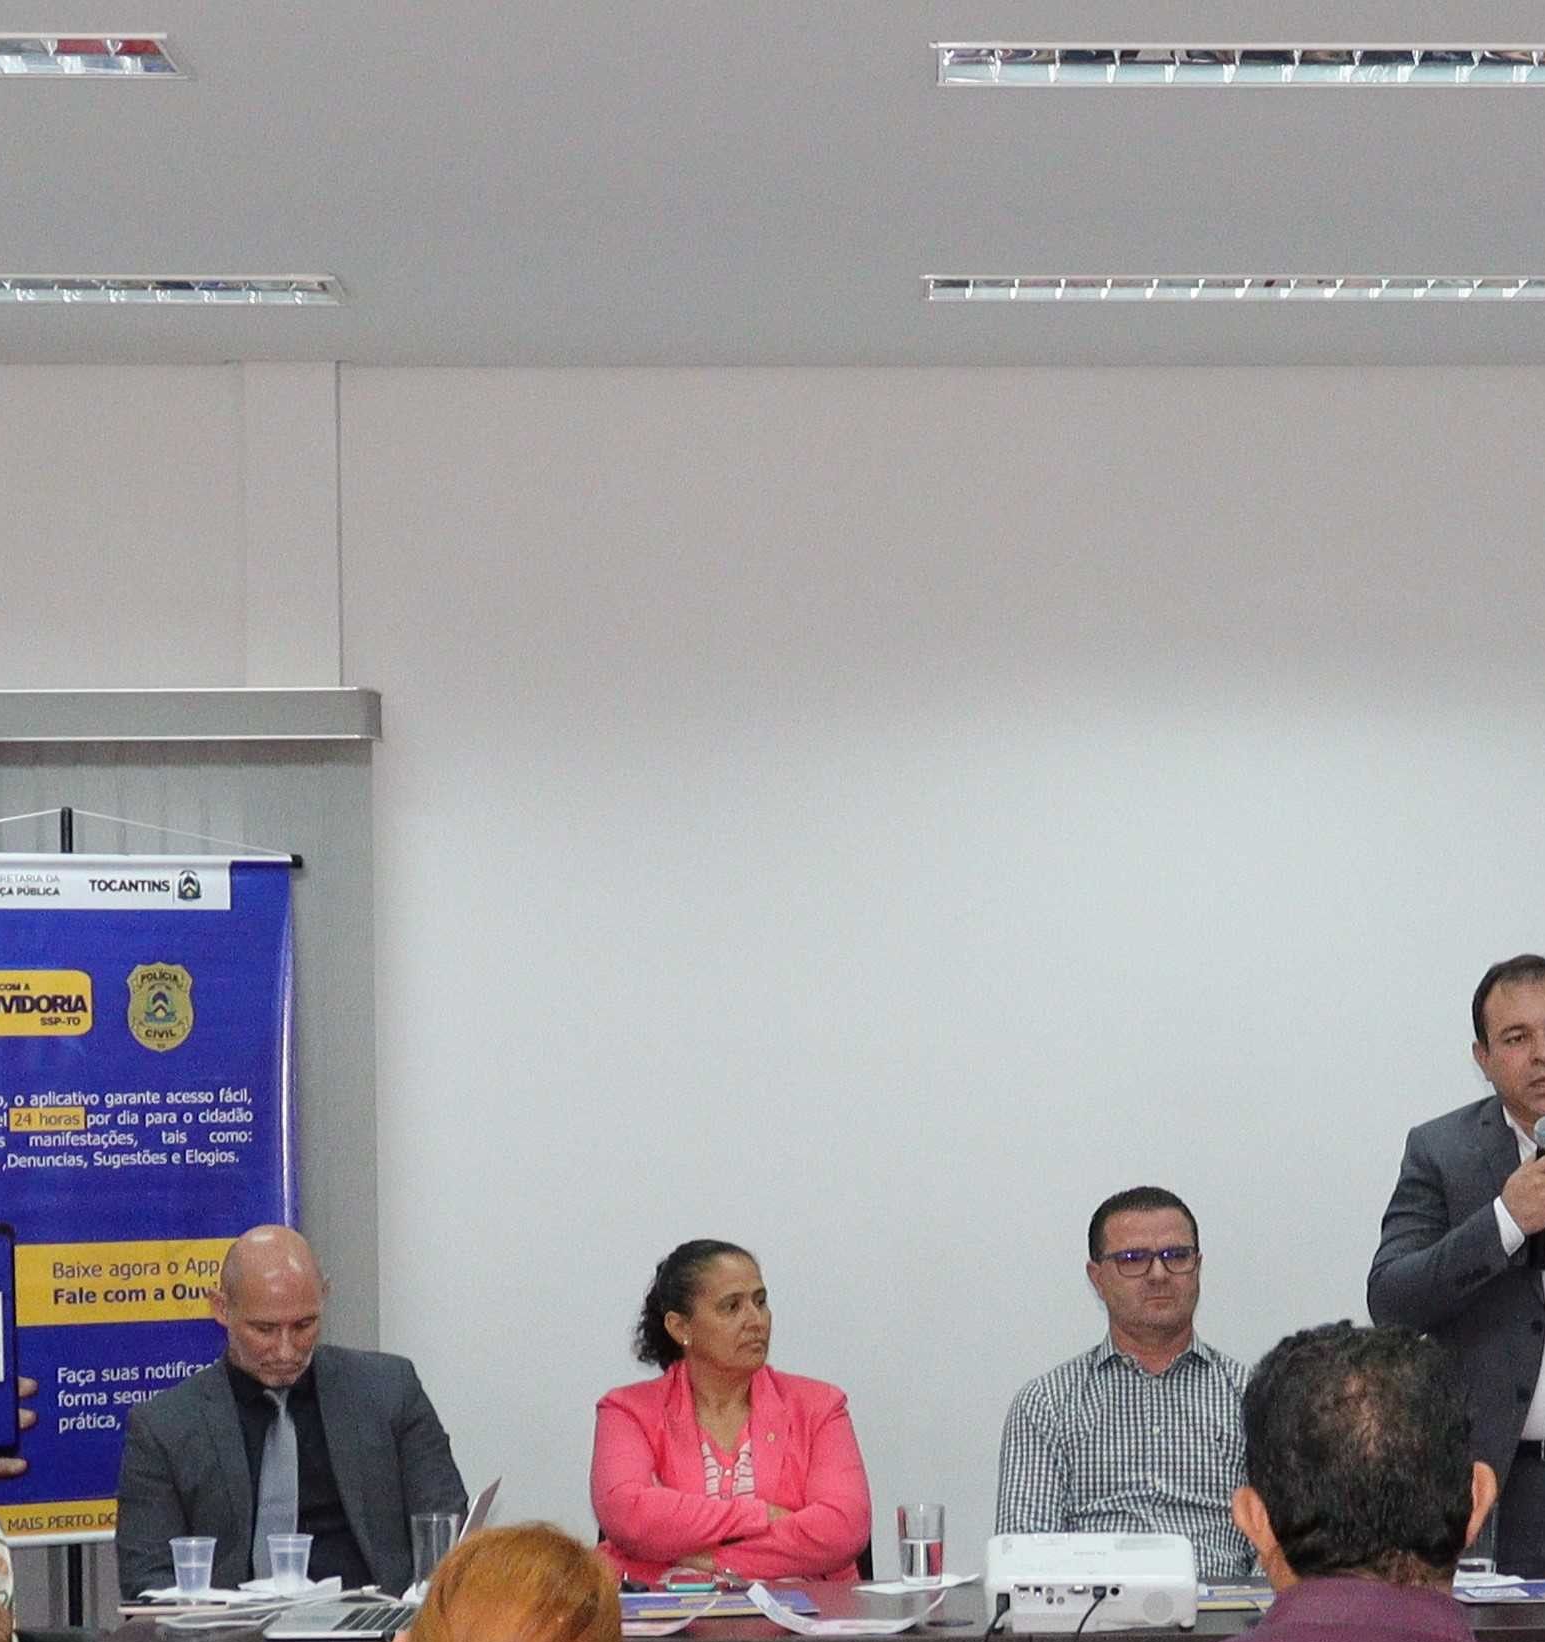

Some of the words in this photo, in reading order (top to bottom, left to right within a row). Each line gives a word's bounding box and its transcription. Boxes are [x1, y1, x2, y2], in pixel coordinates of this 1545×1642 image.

[46, 874, 61, 884] DA
[89, 879, 171, 893] TOCANTINS
[16, 885, 61, 896] PÚBLICA
[23, 983, 31, 991] A
[40, 1016, 81, 1026] SSP-TO
[145, 1029, 177, 1039] CIVIL
[14, 1095, 24, 1107] o
[29, 1090, 100, 1109] aplicativo
[104, 1090, 161, 1108] garante
[166, 1092, 214, 1105] acesso
[219, 1087, 252, 1105] fácil,
[14, 1113, 32, 1127] 24
[39, 1111, 81, 1126] horas
[86, 1112, 111, 1128] por
[117, 1110, 139, 1125] dia
[145, 1111, 178, 1128] para
[183, 1112, 193, 1124] o
[198, 1106, 253, 1124] cidadão
[29, 1130, 139, 1149] manifestações,
[161, 1129, 188, 1145] tais
[209, 1130, 253, 1144] como:
[93, 1149, 168, 1170] Sugestões
[171, 1151, 182, 1164] e
[185, 1148, 240, 1167] Elogios.
[52, 1261, 103, 1279] Baixe
[109, 1262, 160, 1281] agora
[167, 1262, 179, 1275] o
[184, 1257, 220, 1277] App
[53, 1288, 97, 1305] Fale
[103, 1288, 146, 1303] com
[153, 1288, 165, 1301] a
[57, 1367, 96, 1387] Faça
[101, 1366, 139, 1381] suas
[57, 1390, 108, 1407] forma
[58, 1411, 121, 1434] prática,
[8, 1516, 43, 1531] MAIS
[47, 1513, 94, 1528] PERTO
